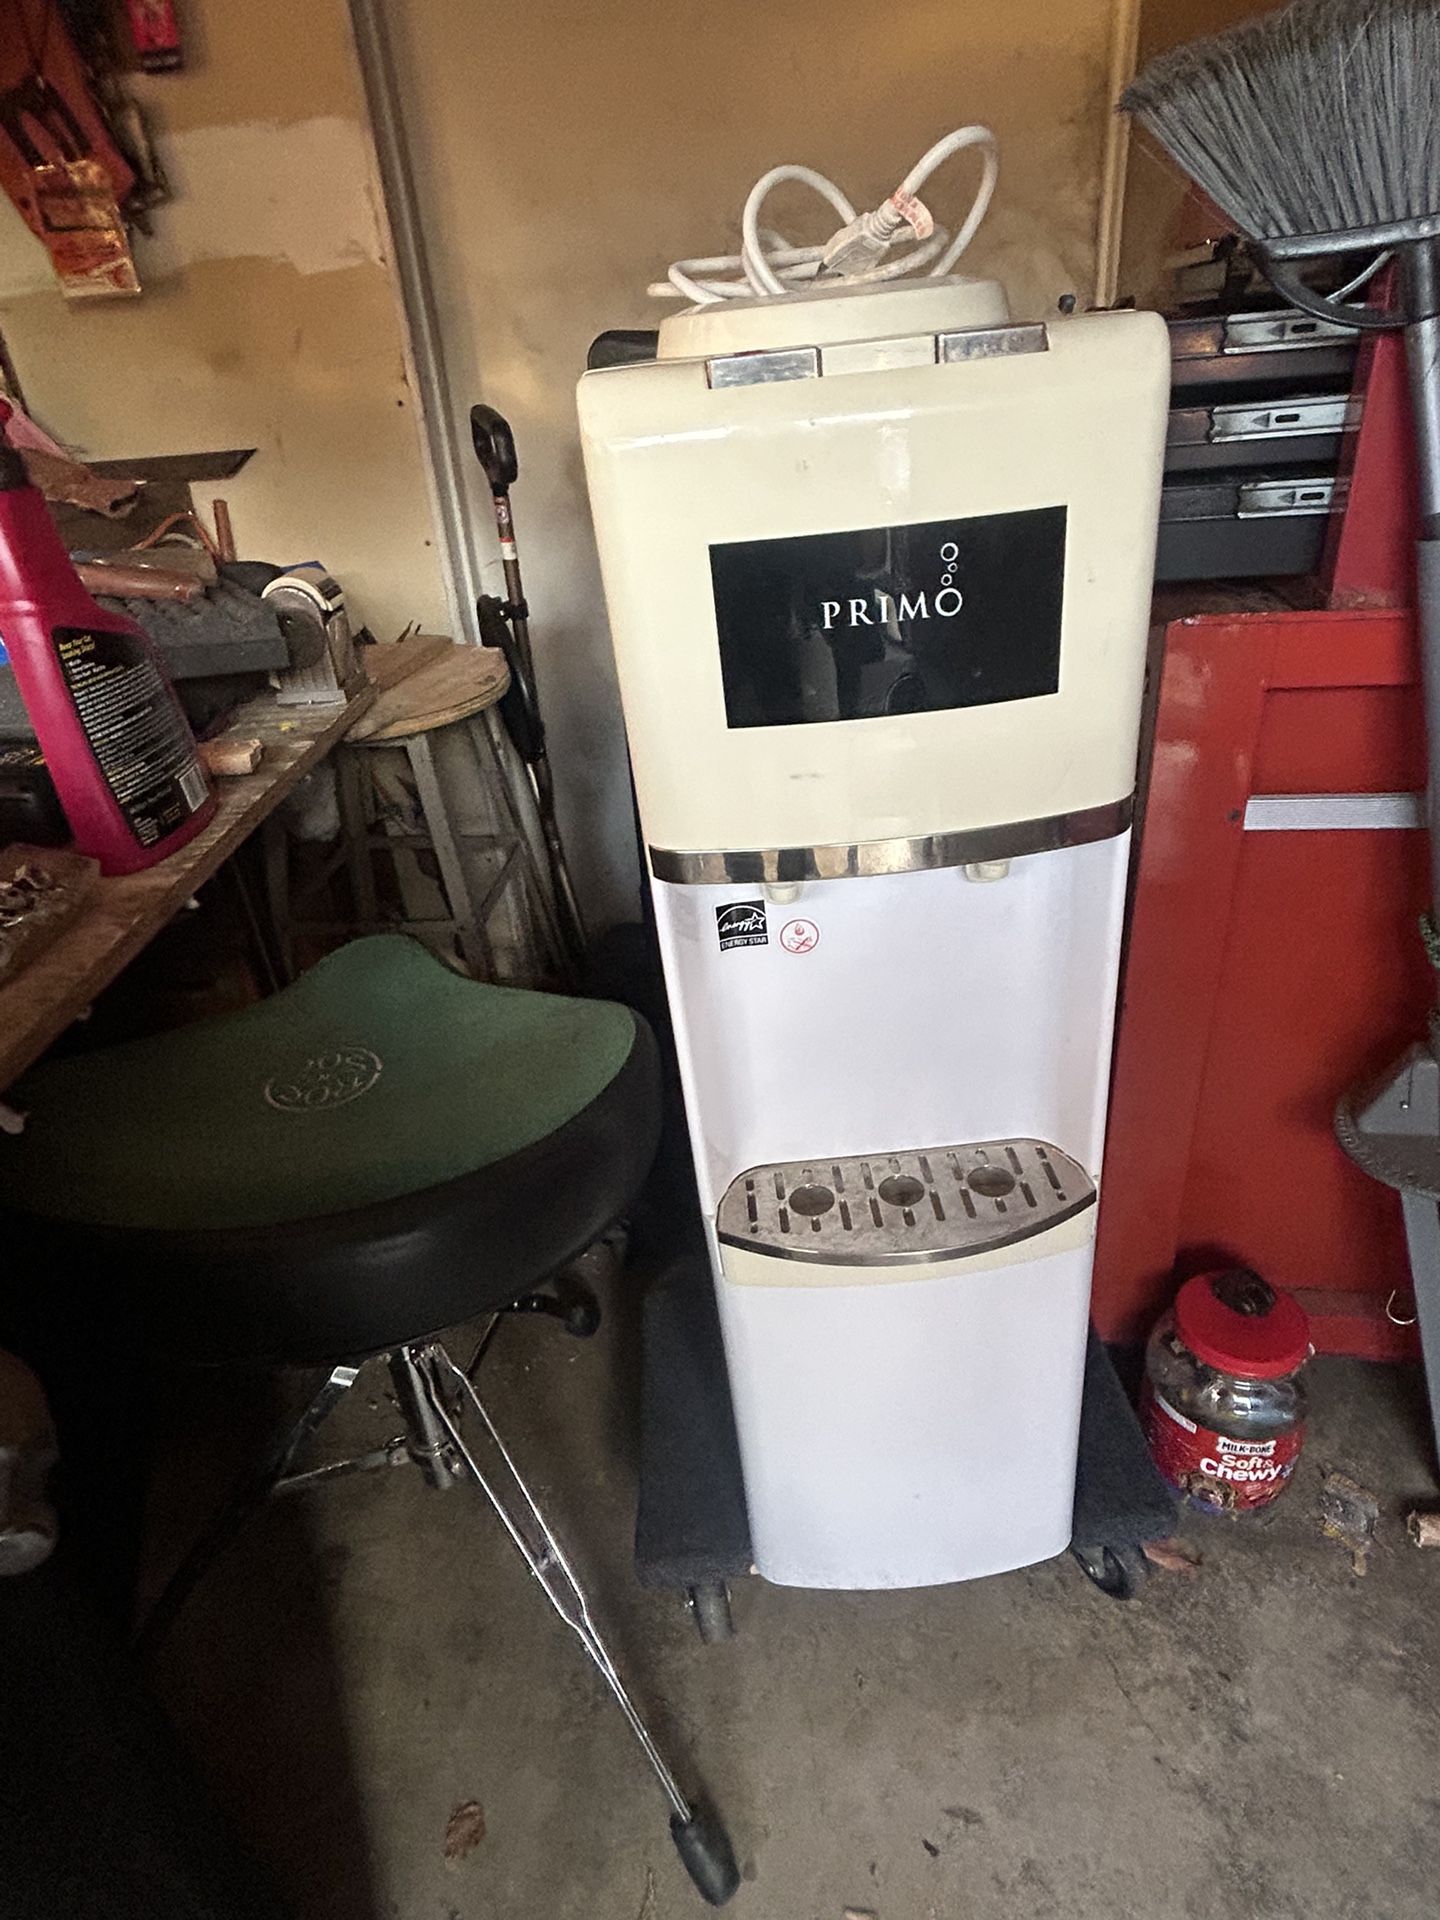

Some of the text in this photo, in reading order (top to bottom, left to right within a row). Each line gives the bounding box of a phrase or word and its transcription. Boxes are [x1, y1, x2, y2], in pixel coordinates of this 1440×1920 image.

[821, 587, 963, 630] PRIMO
[721, 936, 767, 950] ENERGY STAR
[1221, 1442, 1272, 1454] MILK-BONE
[1199, 1457, 1283, 1482] Chewy
[1220, 1454, 1263, 1471] Soft
